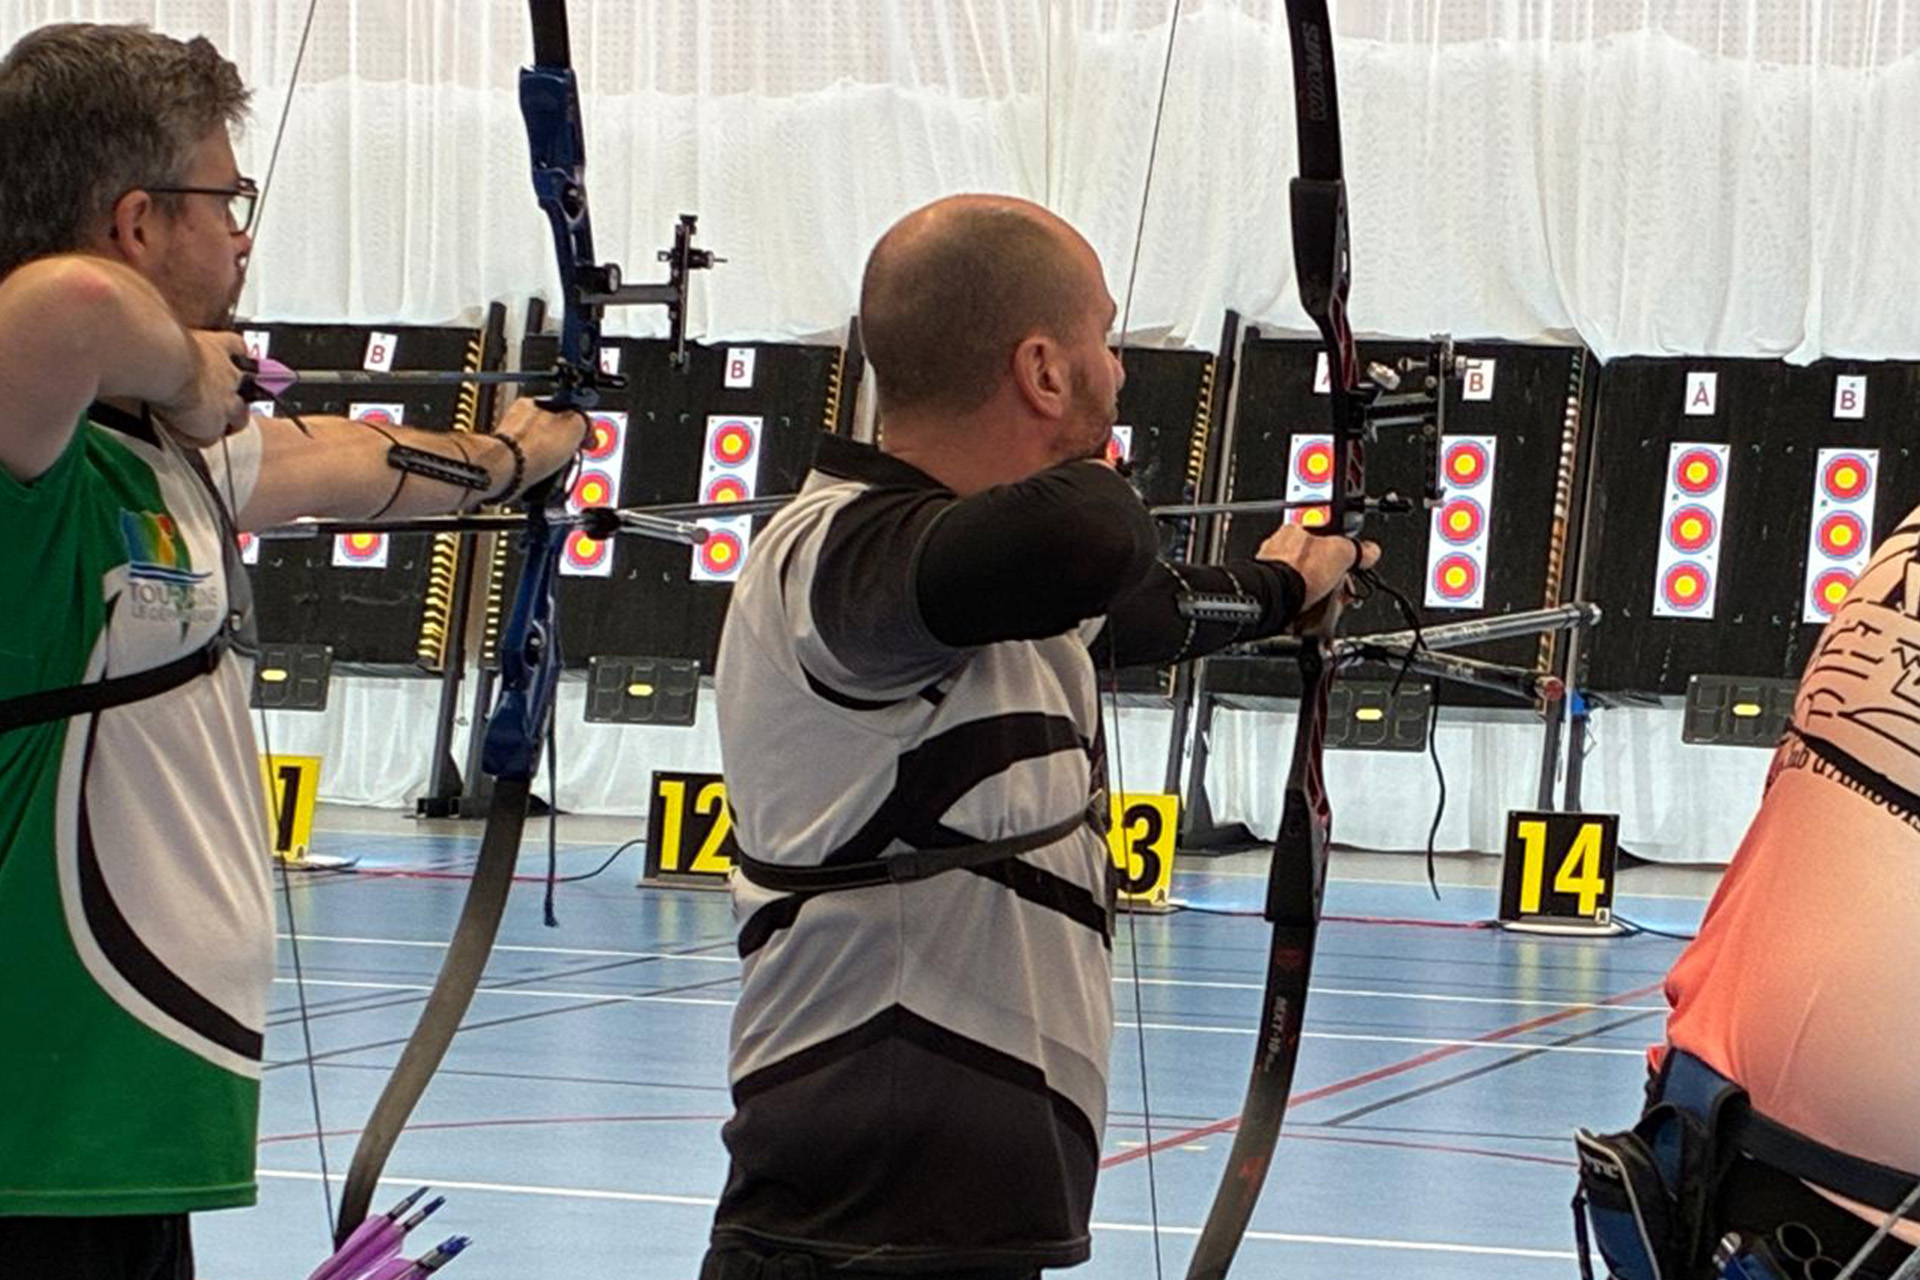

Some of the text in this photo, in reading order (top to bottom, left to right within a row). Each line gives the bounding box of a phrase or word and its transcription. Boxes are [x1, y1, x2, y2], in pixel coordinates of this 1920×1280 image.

[370, 344, 386, 364] B
[730, 360, 746, 379] B
[1469, 372, 1484, 392] B
[1692, 384, 1710, 407] A
[1840, 389, 1856, 410] B
[659, 780, 732, 872] 12
[1518, 821, 1605, 915] 14
